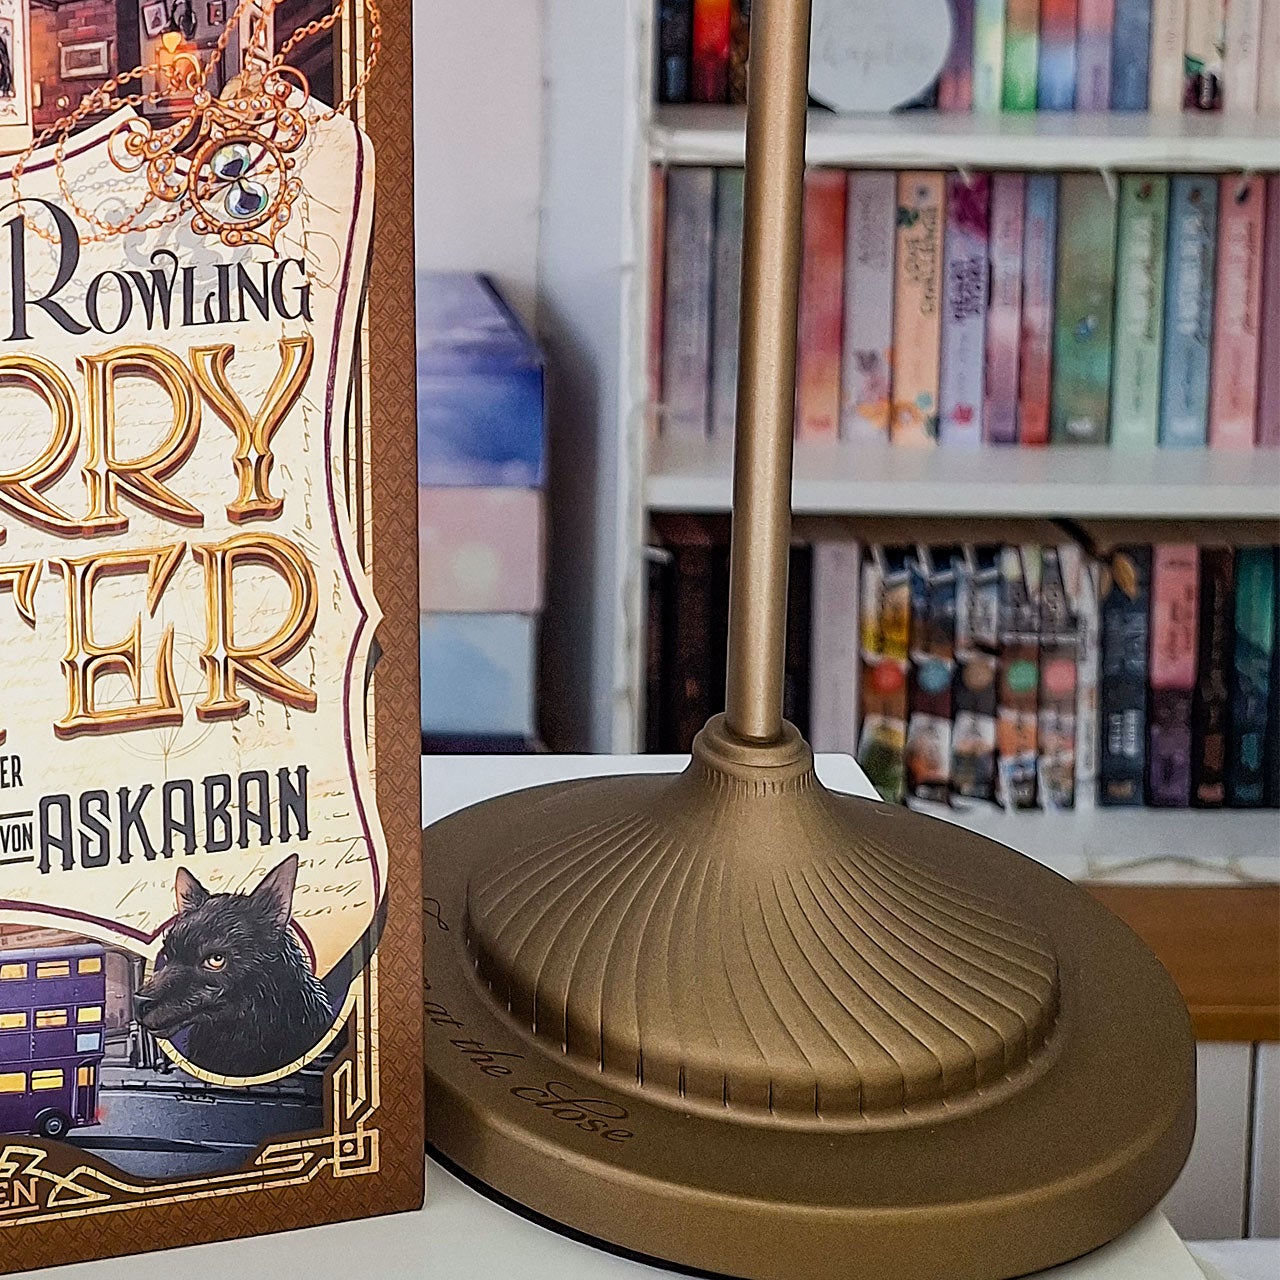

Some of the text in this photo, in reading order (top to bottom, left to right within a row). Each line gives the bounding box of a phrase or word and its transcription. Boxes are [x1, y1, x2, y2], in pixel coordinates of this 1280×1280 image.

[0, 822, 35, 856] VON
[36, 764, 313, 875] ASKABAN
[450, 1038, 525, 1078] the
[510, 1081, 634, 1143] close
